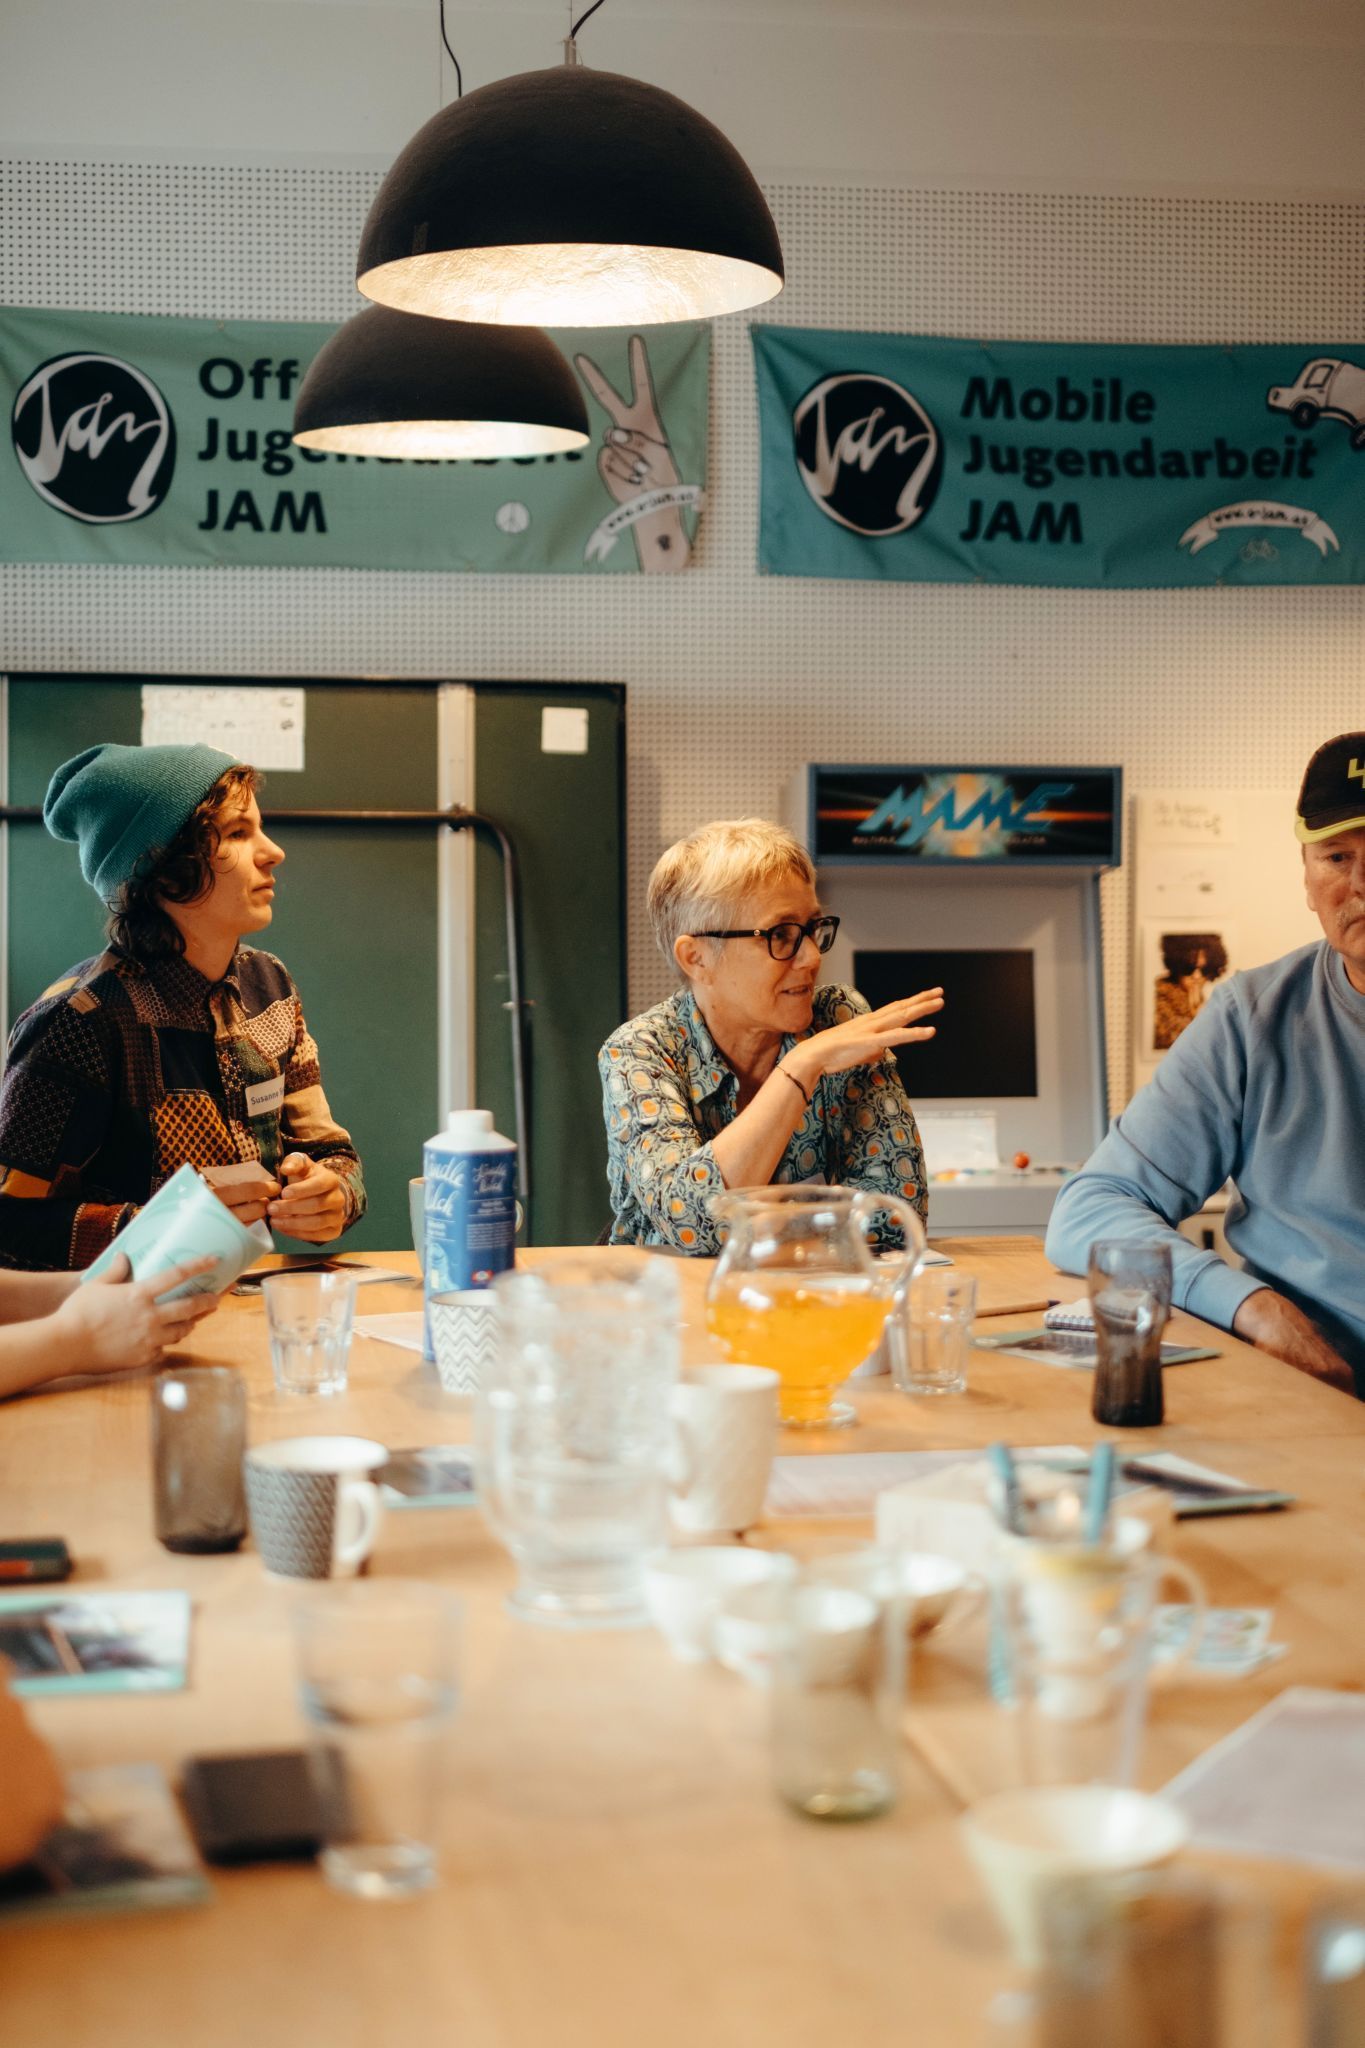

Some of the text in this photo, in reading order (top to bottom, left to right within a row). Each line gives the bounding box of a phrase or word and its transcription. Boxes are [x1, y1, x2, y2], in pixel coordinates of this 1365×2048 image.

[198, 357, 299, 401] Off
[960, 376, 1156, 423] Mobile
[963, 434, 1319, 489] Jugendarbeit
[198, 489, 328, 533] JAM
[959, 500, 1083, 545] JAM
[856, 783, 1077, 847] MAME
